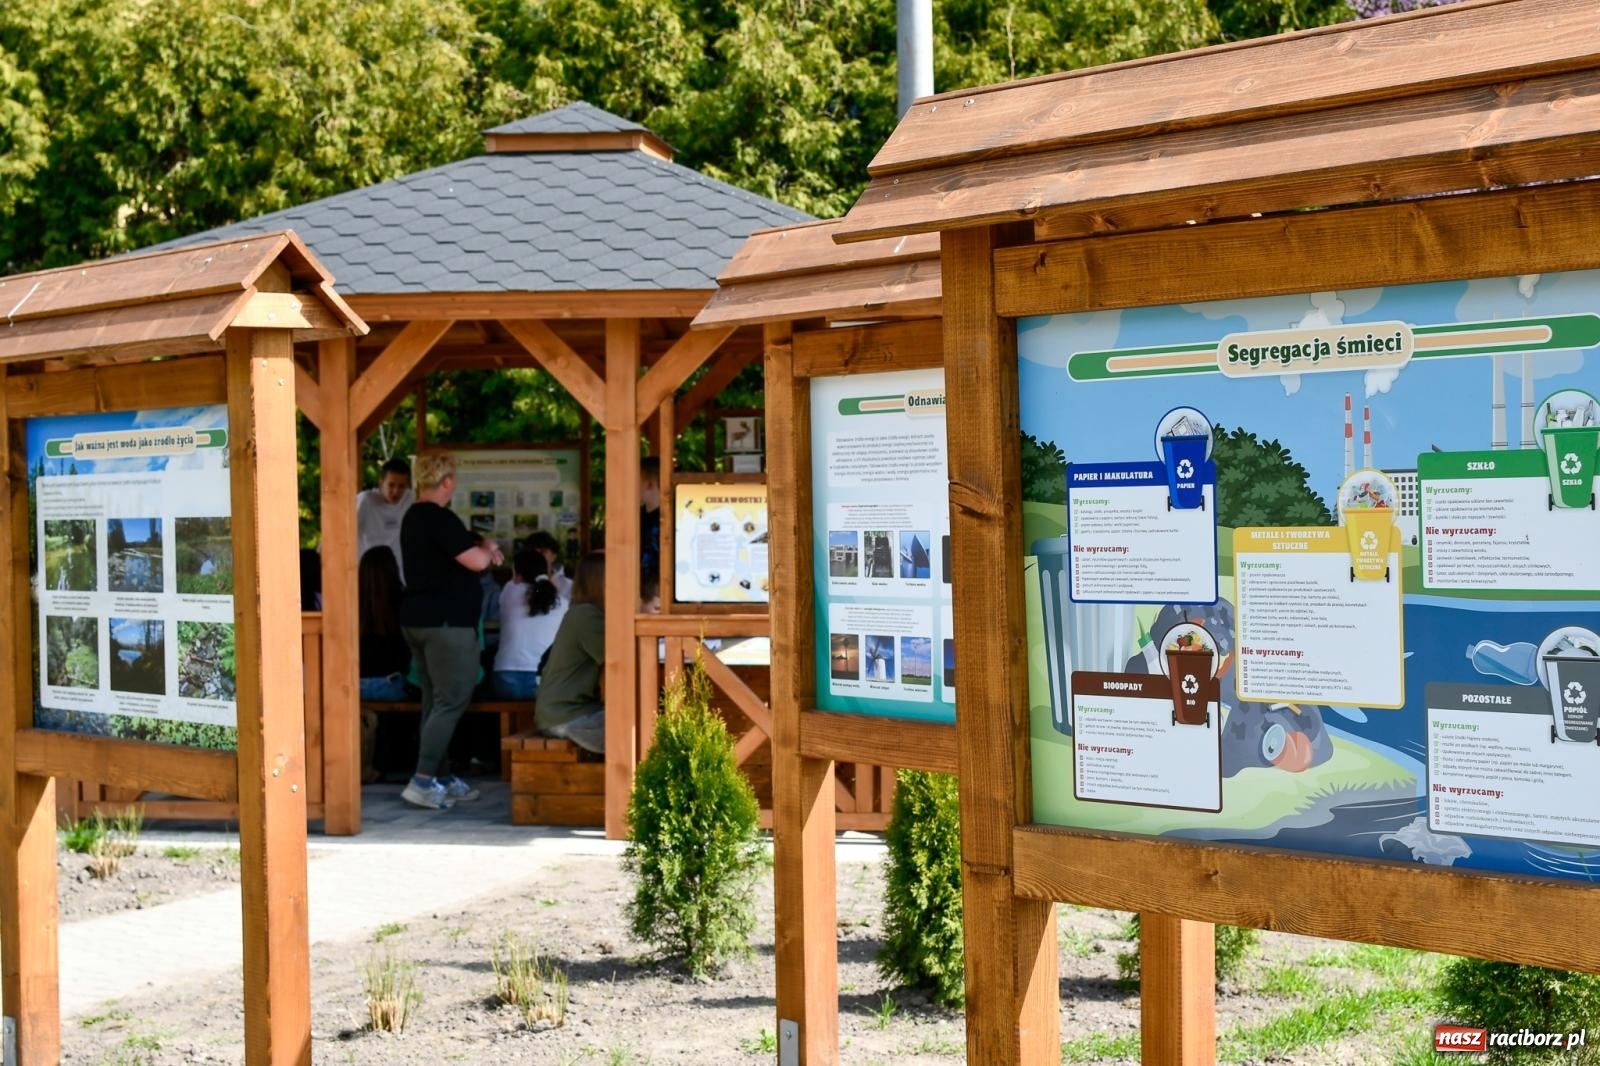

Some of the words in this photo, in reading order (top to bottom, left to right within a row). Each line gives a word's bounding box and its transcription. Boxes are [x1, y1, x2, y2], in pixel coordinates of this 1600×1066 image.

[1228, 338, 1330, 366] Segregacja
[1337, 332, 1402, 355] śmieci
[106, 440, 118, 451] jest
[120, 437, 137, 448] woda
[139, 436, 152, 449] jako
[177, 434, 194, 447] życia
[1467, 461, 1495, 471] SZKŁO
[1073, 473, 1098, 481] PAPIER
[1100, 472, 1103, 480] I
[1104, 471, 1153, 480] MAKULATURA
[1426, 486, 1472, 495] Wyrzucamy:
[1073, 499, 1110, 507] Wyrzucamy:
[1251, 531, 1280, 539] METALE
[1285, 531, 1330, 539] TWORZYWA
[1425, 526, 1439, 535] Nie
[1442, 527, 1497, 537] wyrzucamy:
[1073, 545, 1085, 553] Nie
[1086, 546, 1129, 555] wyrzucamy:
[1240, 561, 1282, 570] Wyrzucamy:
[1241, 647, 1254, 655] Nie
[1256, 649, 1304, 658] wyrzucamy:
[1103, 682, 1143, 691] BIOODPADY
[1462, 694, 1512, 705] POZOSTAŁE
[1077, 705, 1115, 715] Wyrzucamy:
[1563, 705, 1588, 714] POPIÓŁ
[1432, 721, 1479, 731] Wyrzucamy:
[1091, 745, 1134, 756] wyrzucamy:
[1432, 784, 1447, 793] Nie
[1449, 786, 1504, 799] wyrzucamy:
